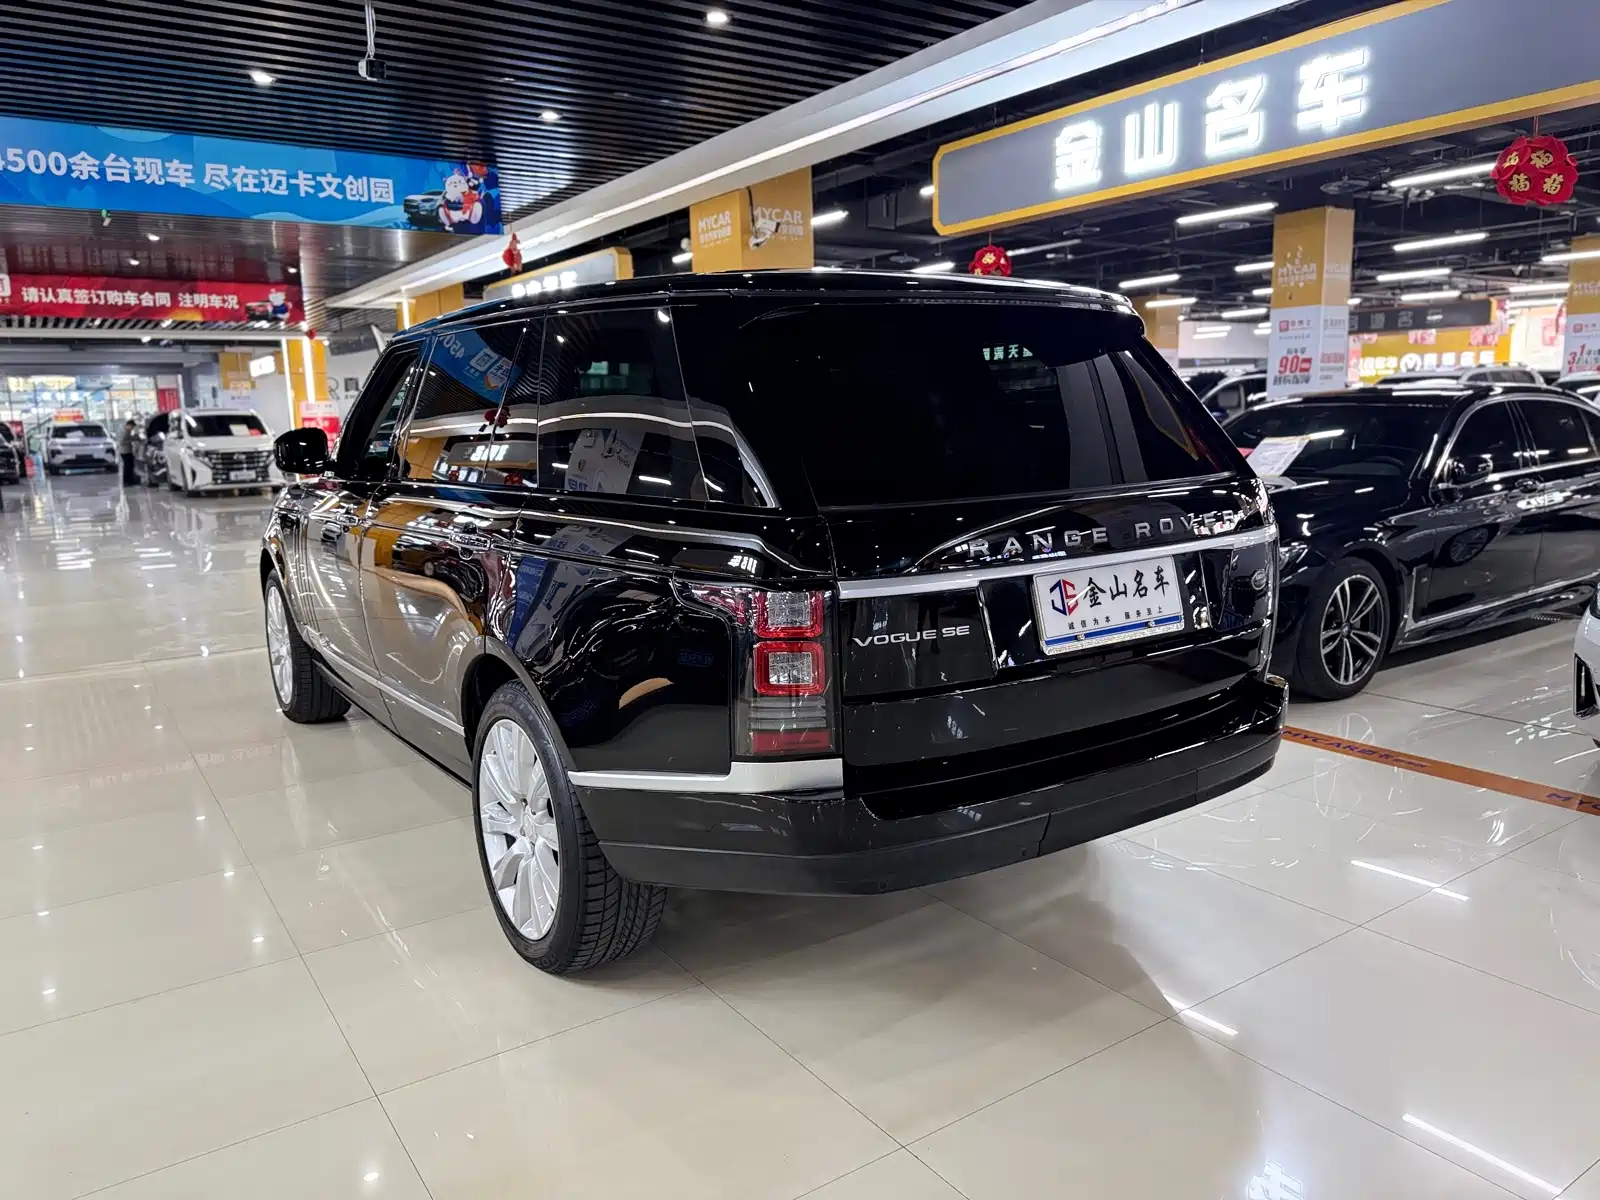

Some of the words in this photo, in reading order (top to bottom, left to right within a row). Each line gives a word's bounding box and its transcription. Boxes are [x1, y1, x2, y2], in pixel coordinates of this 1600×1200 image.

[1053, 46, 1370, 192] 金山名车
[0, 147, 195, 188] 500余台现车
[203, 163, 395, 204] 尽在迈卡文创园
[21, 286, 171, 307] 请认真签订购车合同
[178, 292, 239, 309] 注明车况
[967, 526, 1109, 557] RANGE
[1134, 509, 1245, 541] ROVER
[1083, 565, 1170, 609] 金山名车
[1124, 605, 1164, 620] 服务至上
[852, 629, 937, 647] VOGUE
[941, 625, 970, 638] SE
